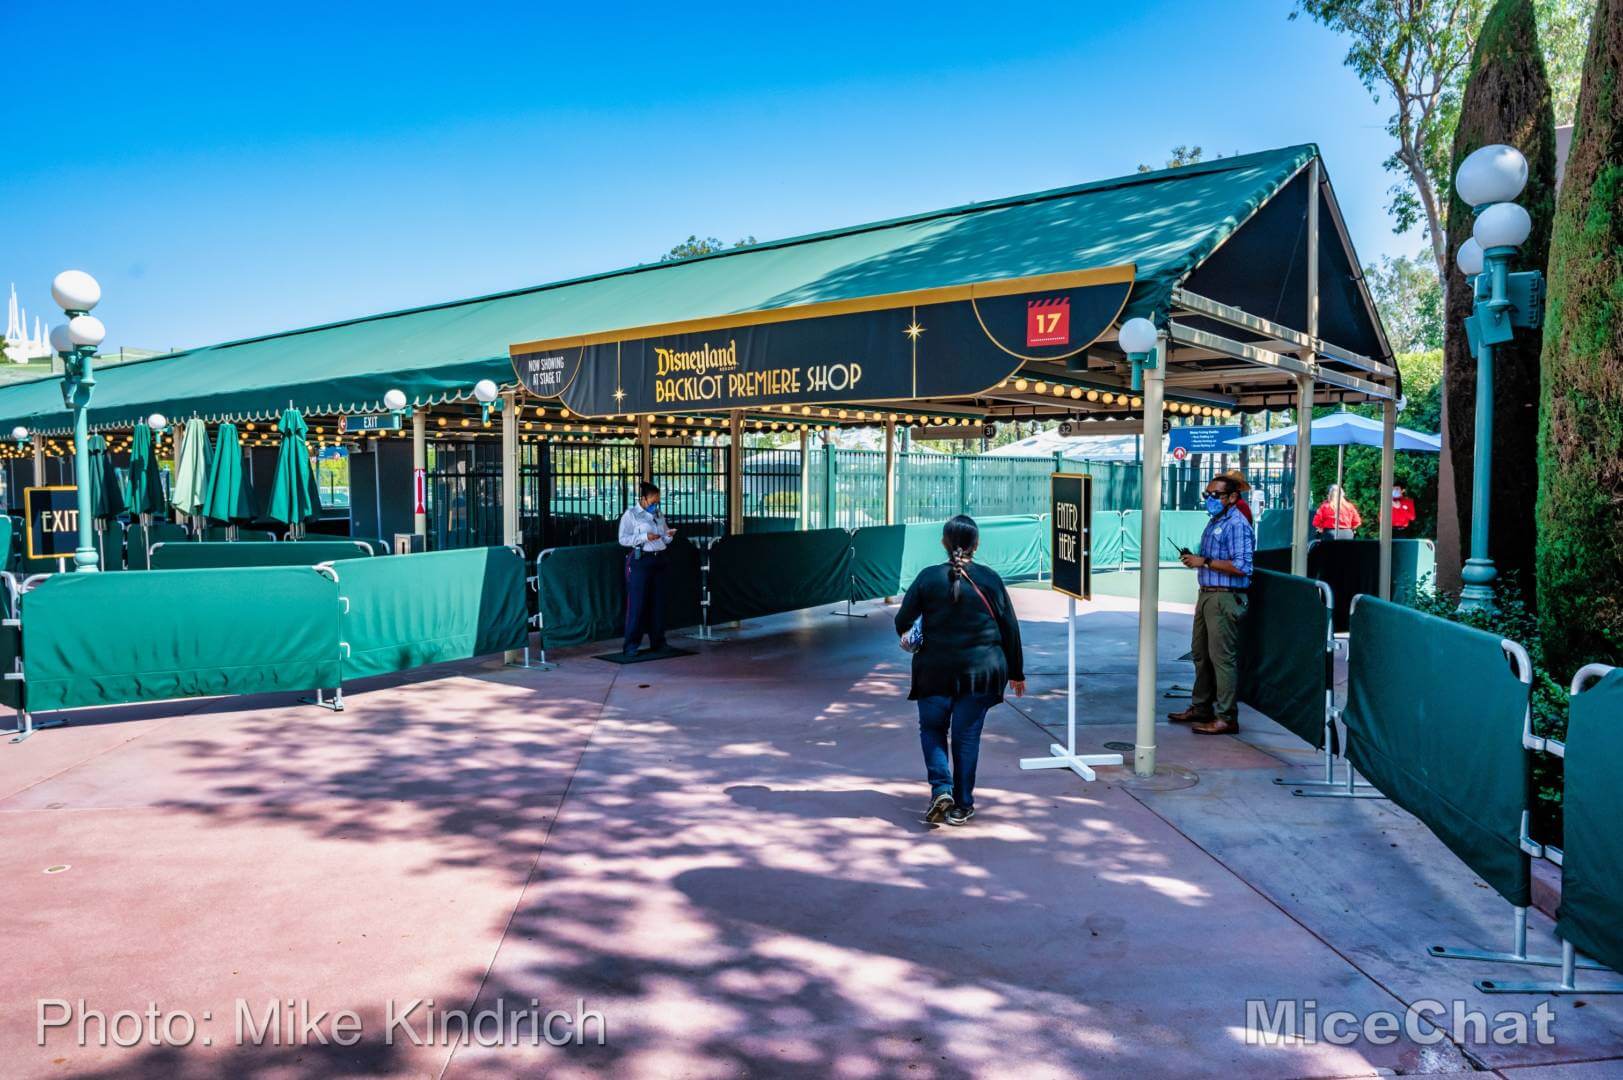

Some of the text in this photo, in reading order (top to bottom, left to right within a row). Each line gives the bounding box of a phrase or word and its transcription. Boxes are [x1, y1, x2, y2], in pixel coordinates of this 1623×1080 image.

[1036, 313, 1062, 334] 17
[529, 356, 565, 372] NOW SHOWING
[655, 339, 737, 376] Disneyland
[533, 373, 539, 386] AT
[540, 371, 555, 385] STAGE
[656, 363, 862, 402] BACKLOT PREMIERE SHOP
[363, 416, 378, 429] EXIT
[985, 426, 994, 437] 31
[1060, 424, 1071, 434] 32
[41, 510, 80, 533] EXIT
[1057, 502, 1078, 532] ENTER
[1059, 533, 1076, 563] HERE
